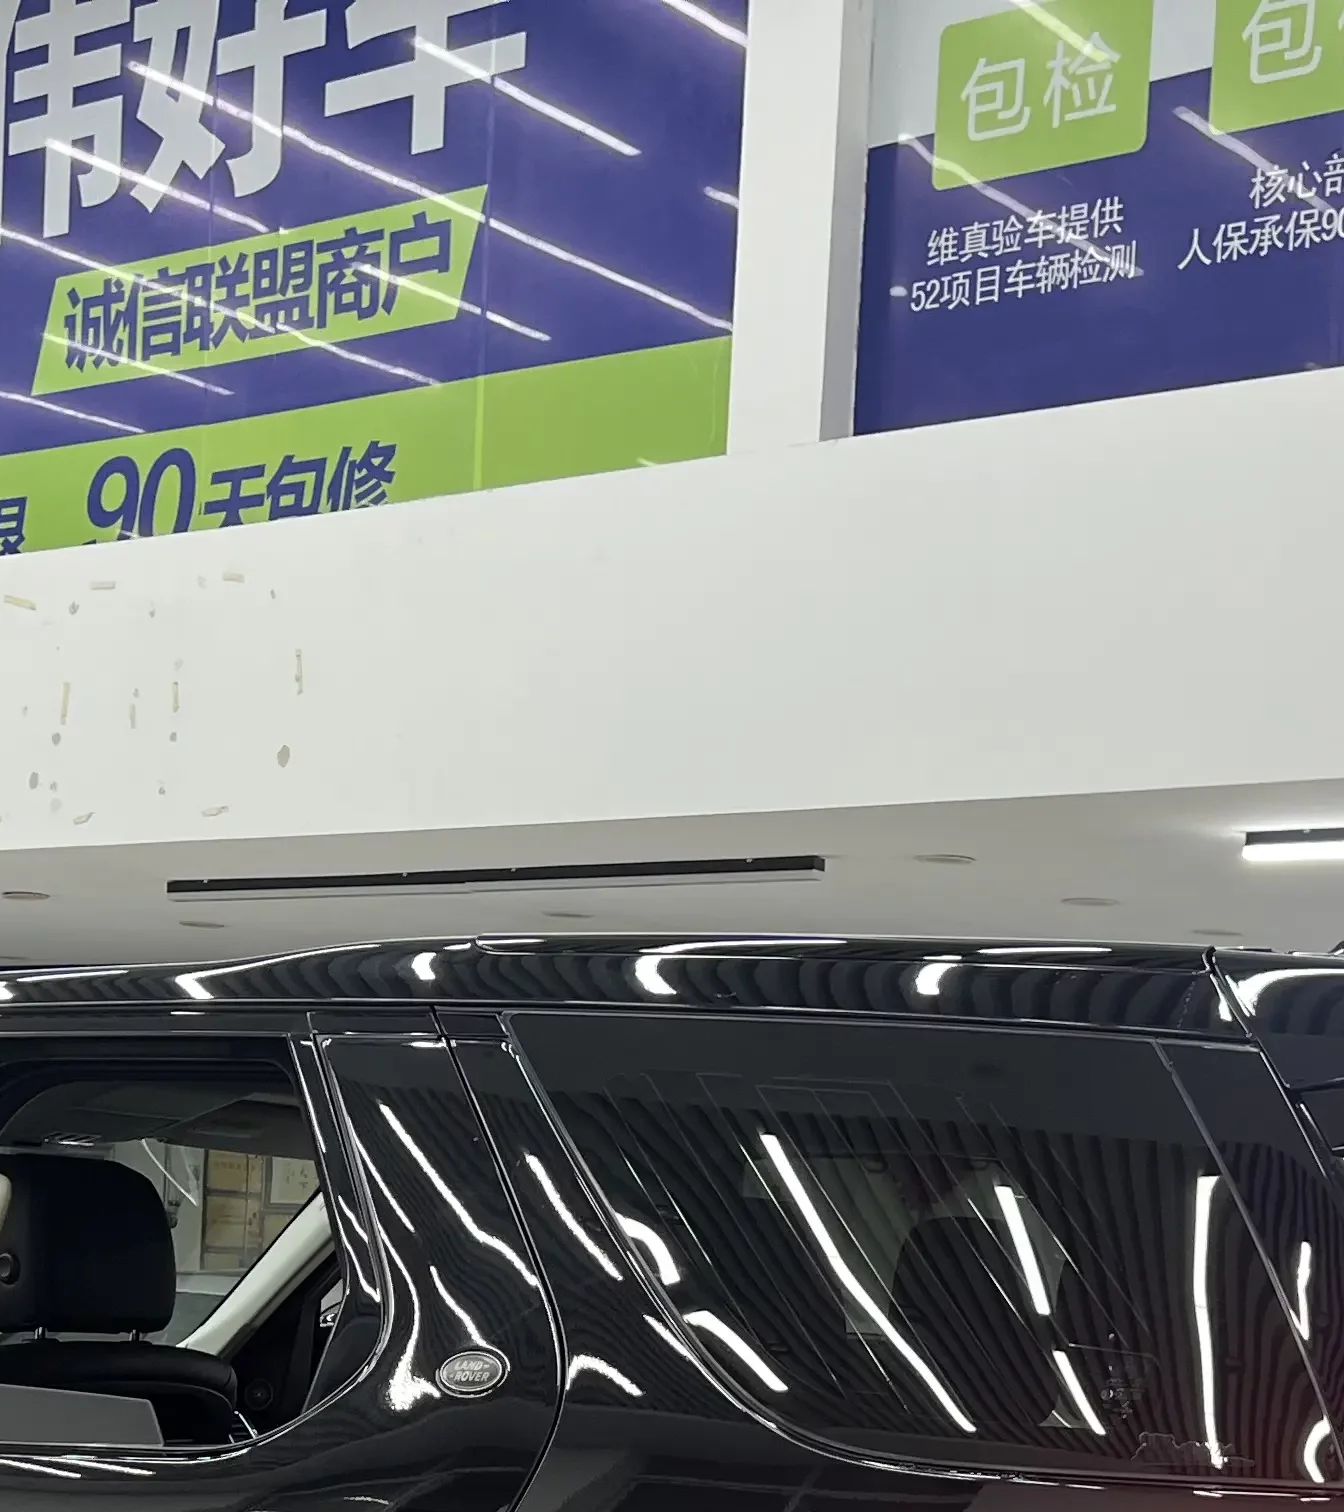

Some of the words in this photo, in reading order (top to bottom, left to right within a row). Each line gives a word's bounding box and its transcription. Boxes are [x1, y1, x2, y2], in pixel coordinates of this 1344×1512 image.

[960, 31, 1121, 141] 包检
[910, 240, 1137, 311] 52项目车辆检测
[926, 196, 1124, 266] 维真验车提供
[64, 212, 452, 374] 诚信联盟商户
